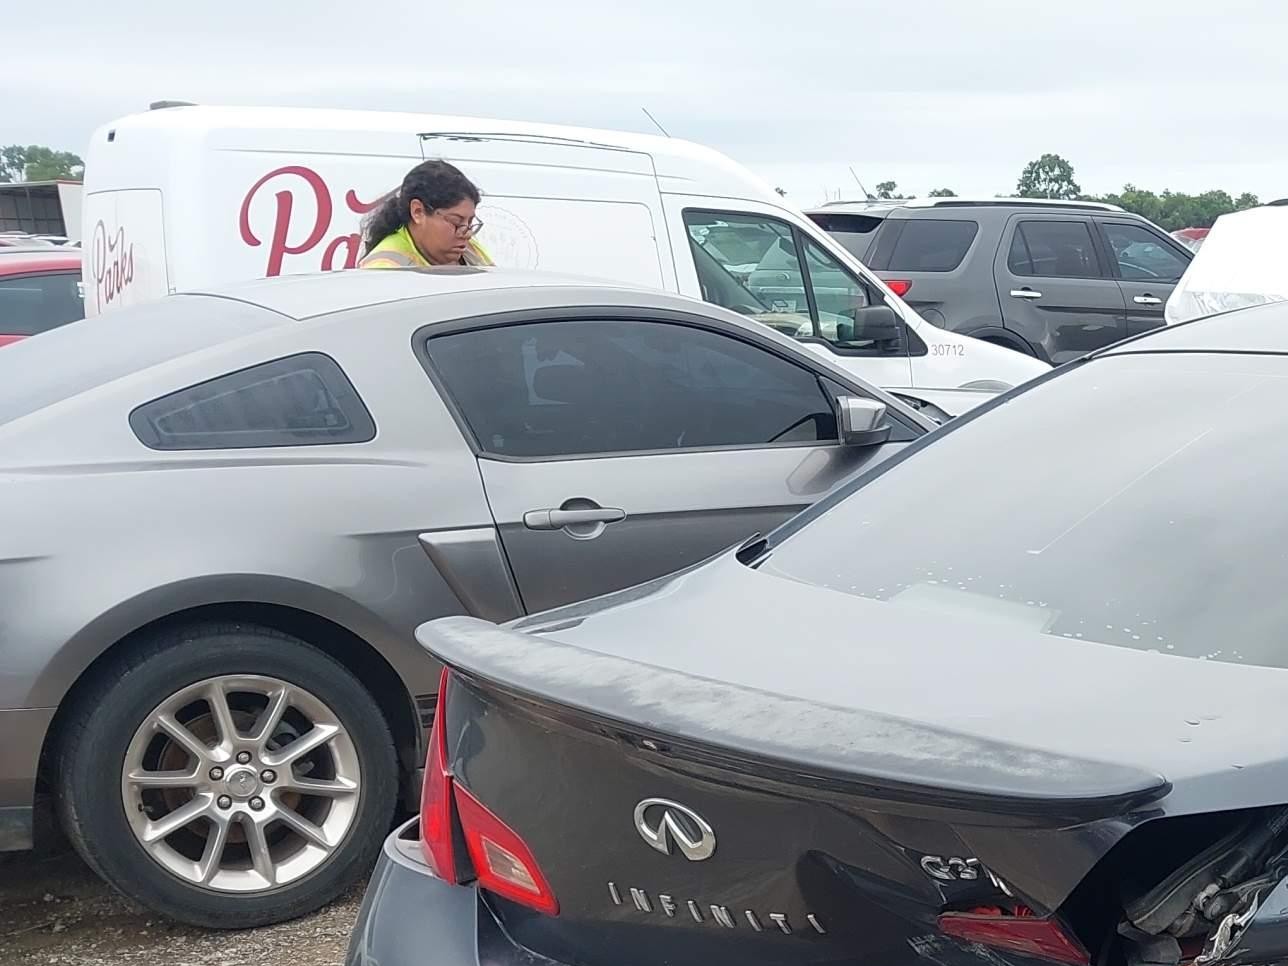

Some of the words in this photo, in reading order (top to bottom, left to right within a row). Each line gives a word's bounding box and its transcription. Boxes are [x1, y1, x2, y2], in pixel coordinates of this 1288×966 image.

[92, 218, 134, 315] Parks
[930, 343, 965, 357] 30712
[607, 881, 827, 935] INFINITI
